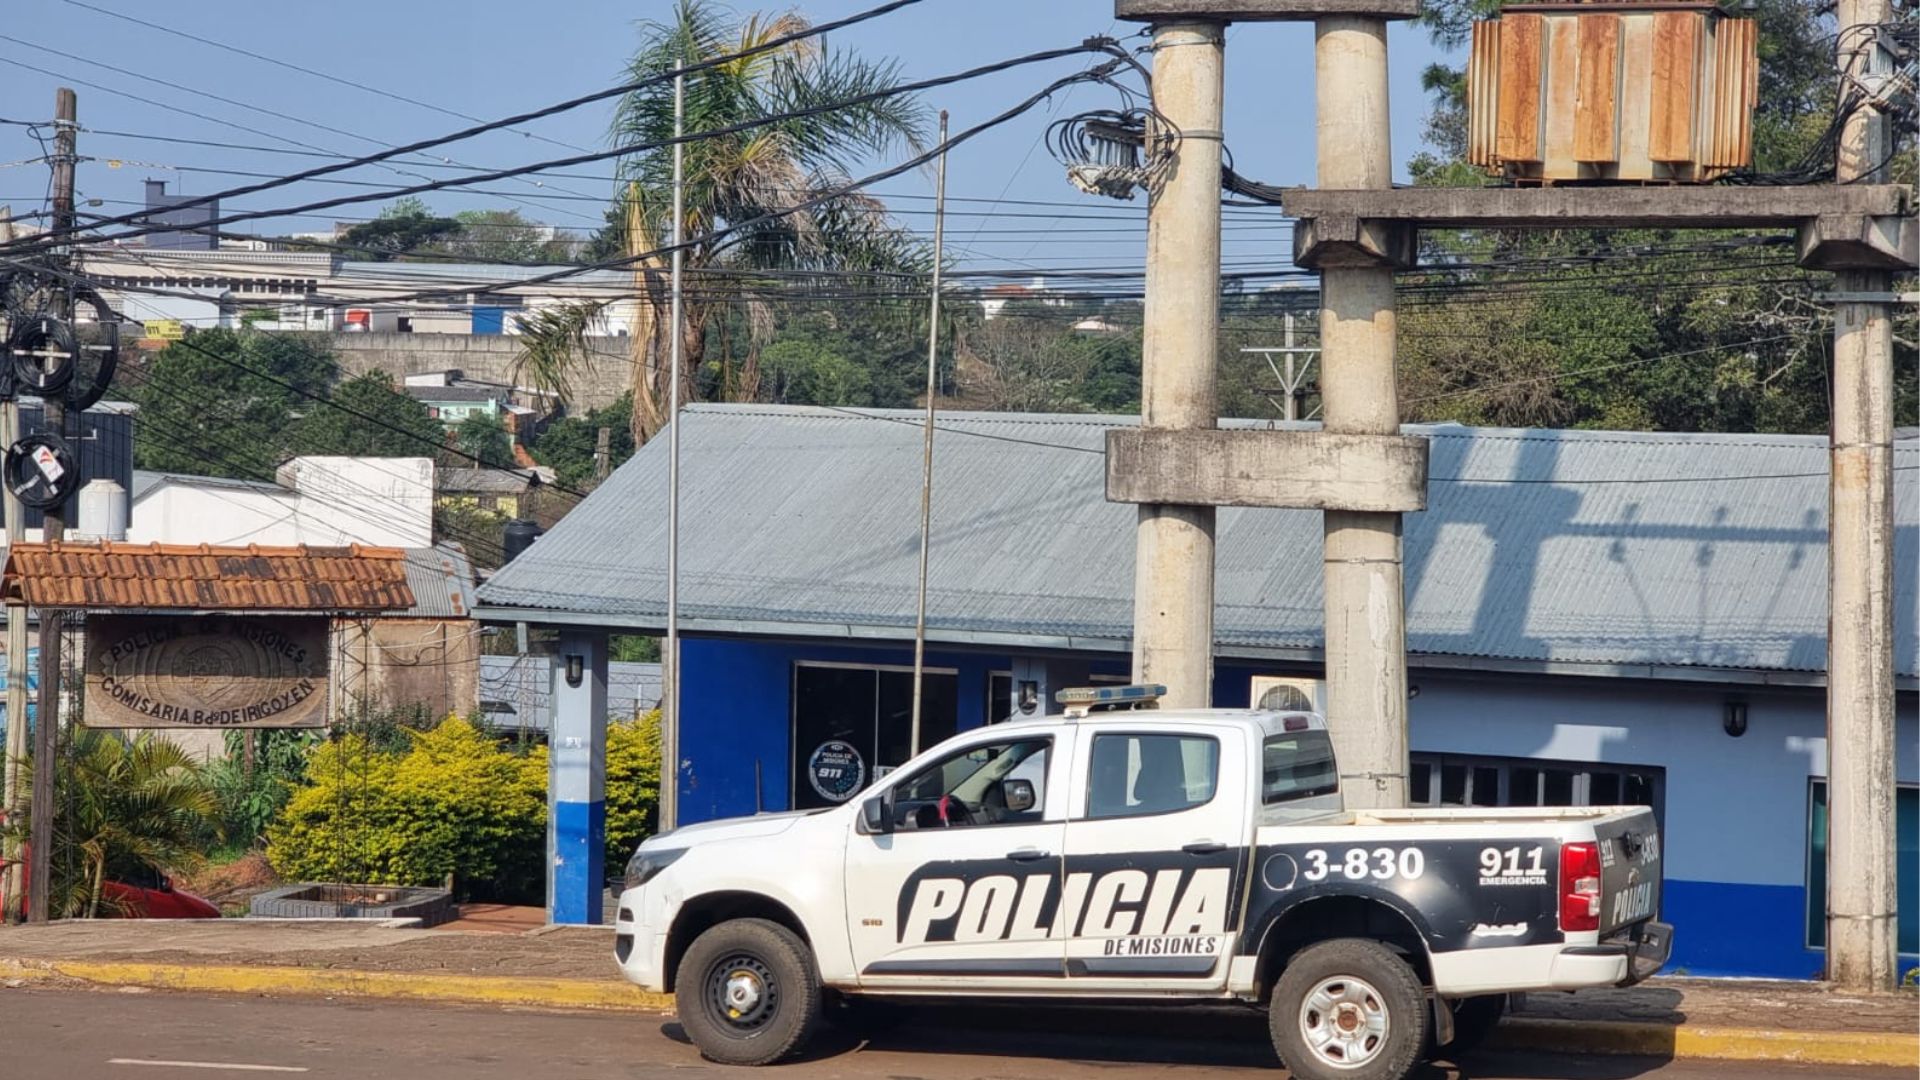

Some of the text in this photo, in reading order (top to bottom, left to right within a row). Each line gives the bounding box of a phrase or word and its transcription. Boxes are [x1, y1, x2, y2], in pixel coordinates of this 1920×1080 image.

[242, 678, 315, 723] IRIGOYEN
[818, 767, 843, 779] 911
[1304, 848, 1424, 881] 3-830
[1479, 846, 1547, 877] 911
[1479, 876, 1547, 886] EMERGENCIA
[901, 868, 1231, 944] POLICIA
[1611, 882, 1651, 926] POLICIA
[1104, 937, 1216, 956] DE MISIONES
